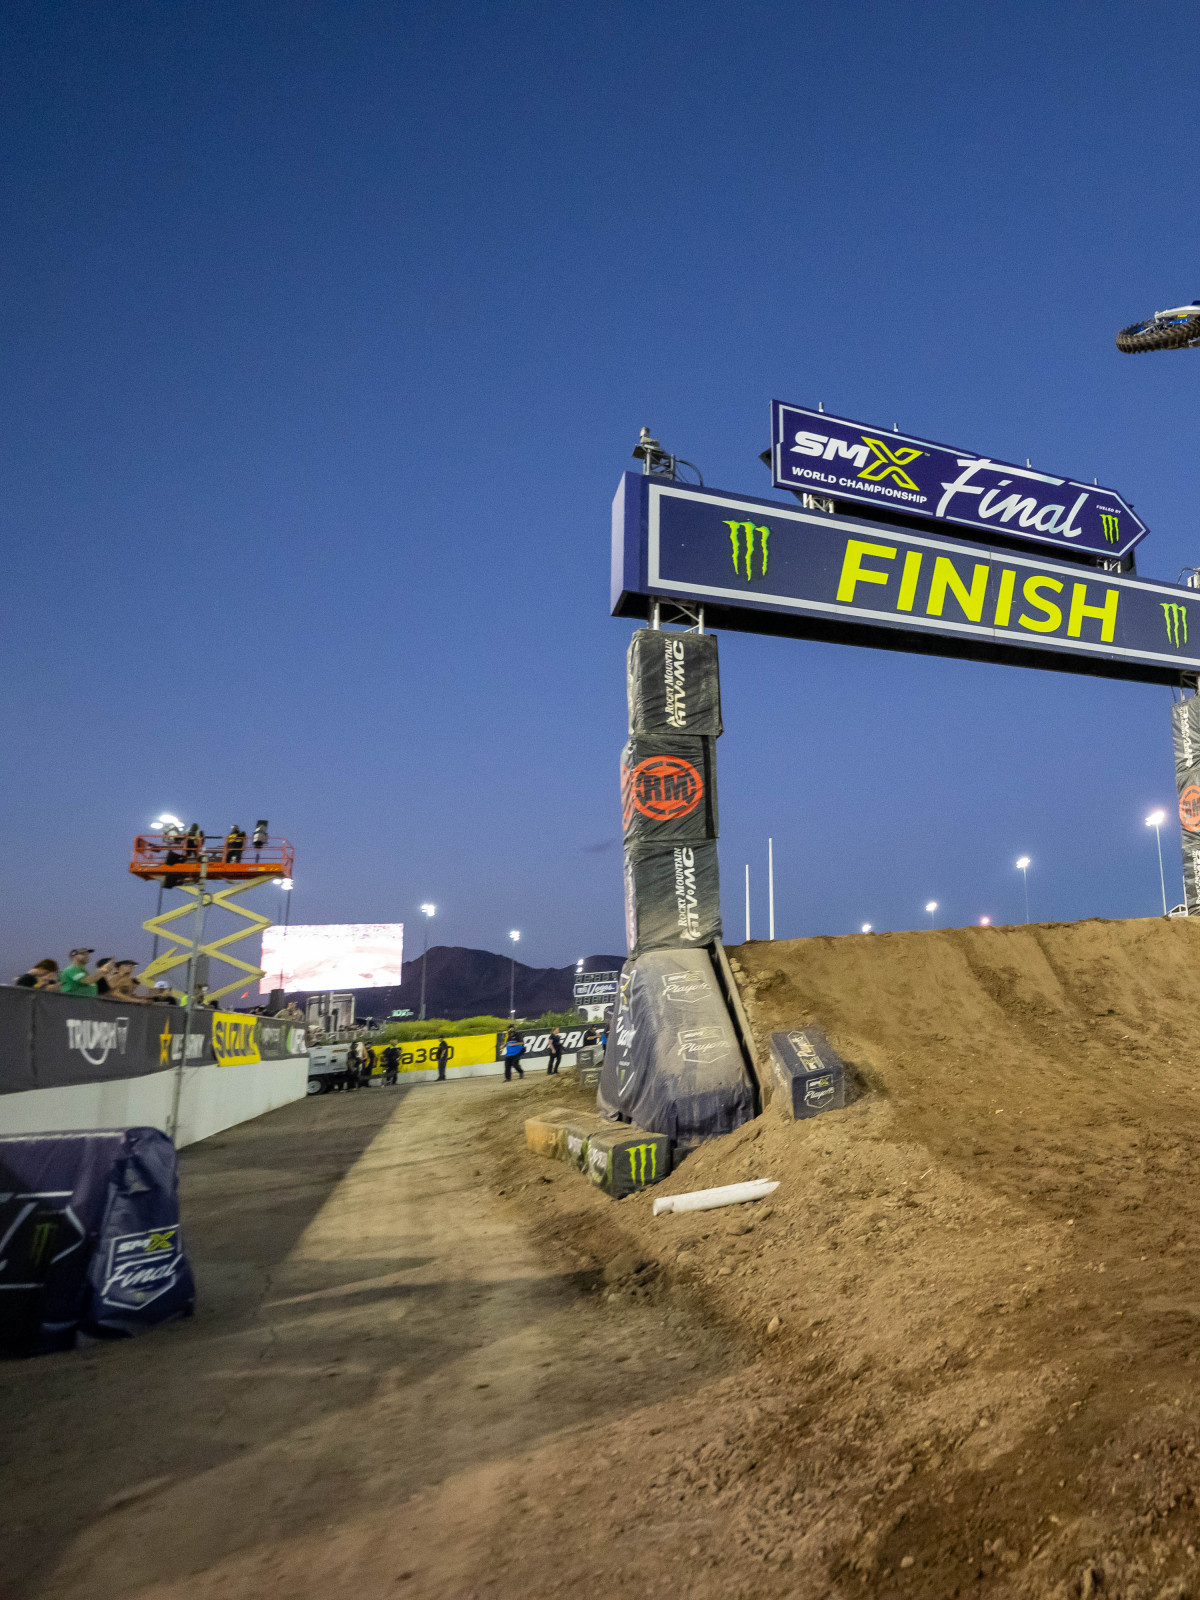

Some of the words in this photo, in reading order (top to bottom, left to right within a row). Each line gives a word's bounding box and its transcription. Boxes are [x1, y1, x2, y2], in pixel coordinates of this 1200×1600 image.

[790, 431, 924, 491] SMX
[792, 466, 837, 484] WORLD
[839, 477, 928, 504] CHAMPIONSHIP
[936, 458, 1089, 538] Final
[836, 539, 1120, 643] FINISH
[664, 638, 675, 686] MOUNTAIN
[664, 686, 675, 714] ROCKY
[674, 847, 686, 897] MOUNTAIN
[101, 1253, 183, 1297] Final
